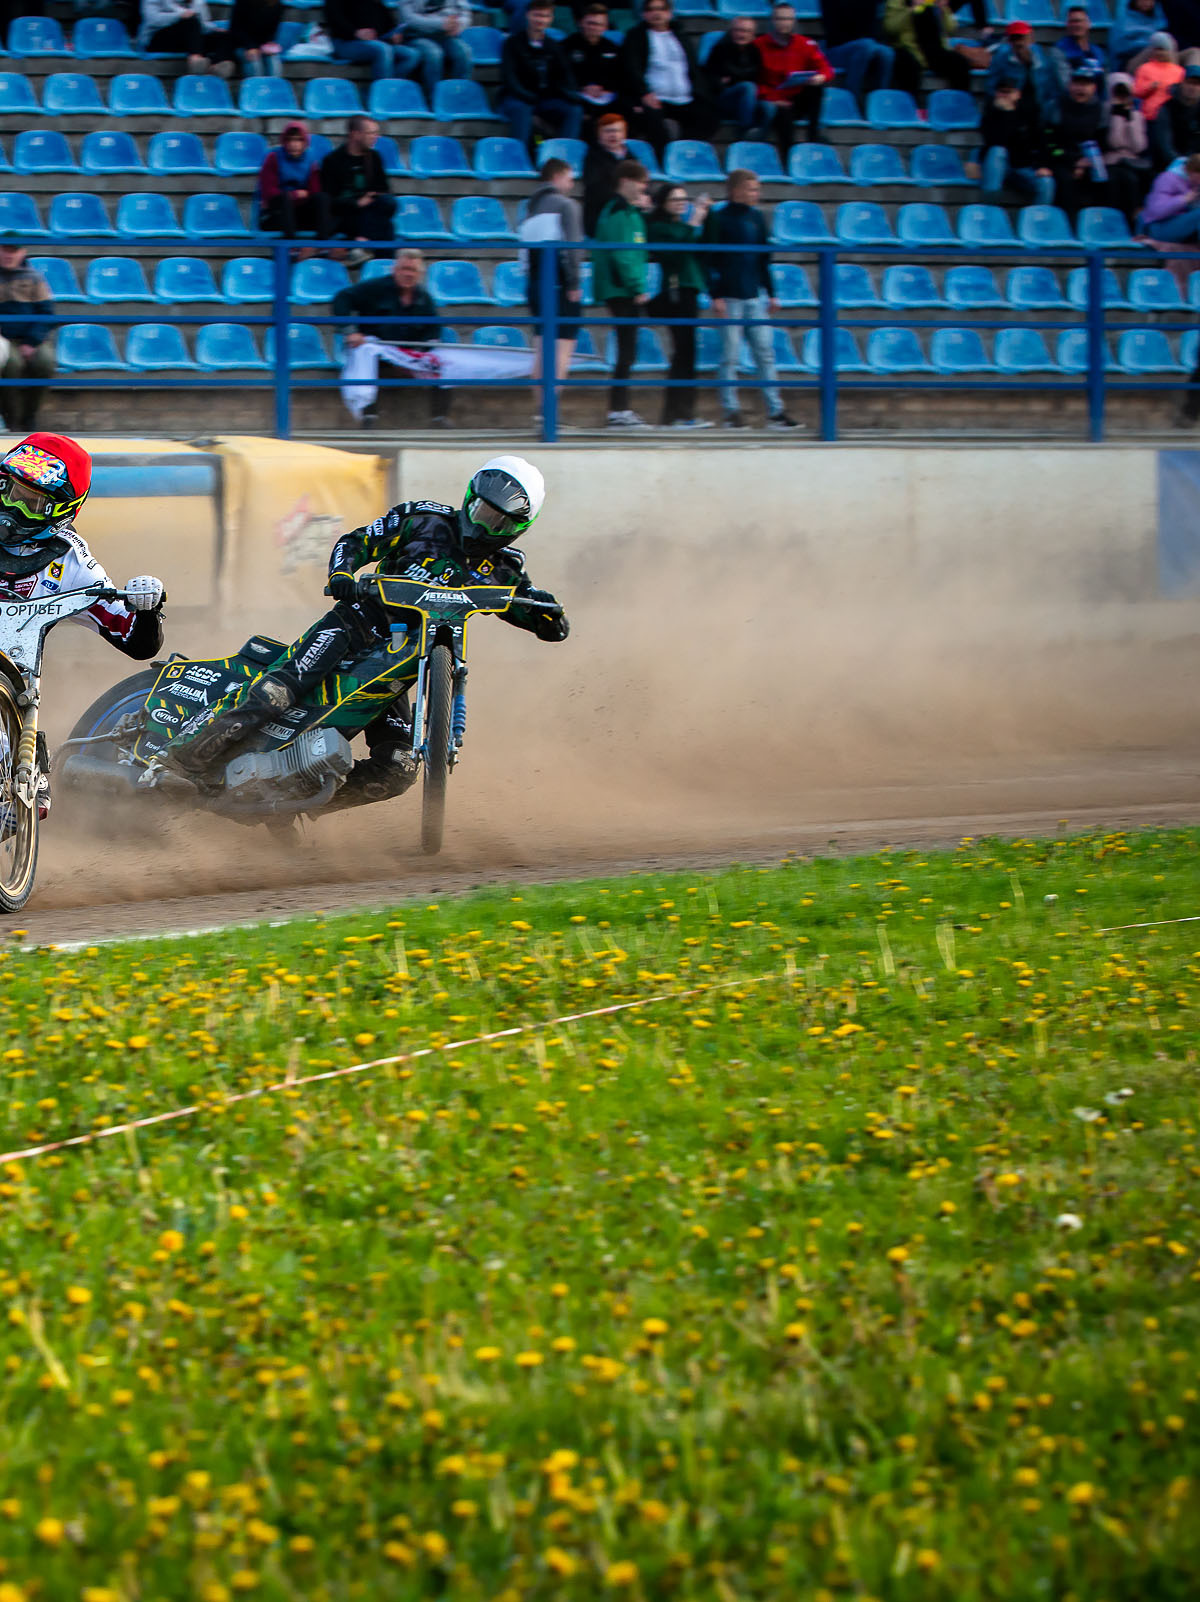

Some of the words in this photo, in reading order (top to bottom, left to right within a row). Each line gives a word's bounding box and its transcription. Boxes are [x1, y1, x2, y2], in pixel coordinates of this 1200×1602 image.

[6, 604, 63, 617] OPTIBET
[295, 628, 346, 680] METALIKA
[157, 680, 209, 707] METALIKA
[156, 711, 179, 724] WIKO
